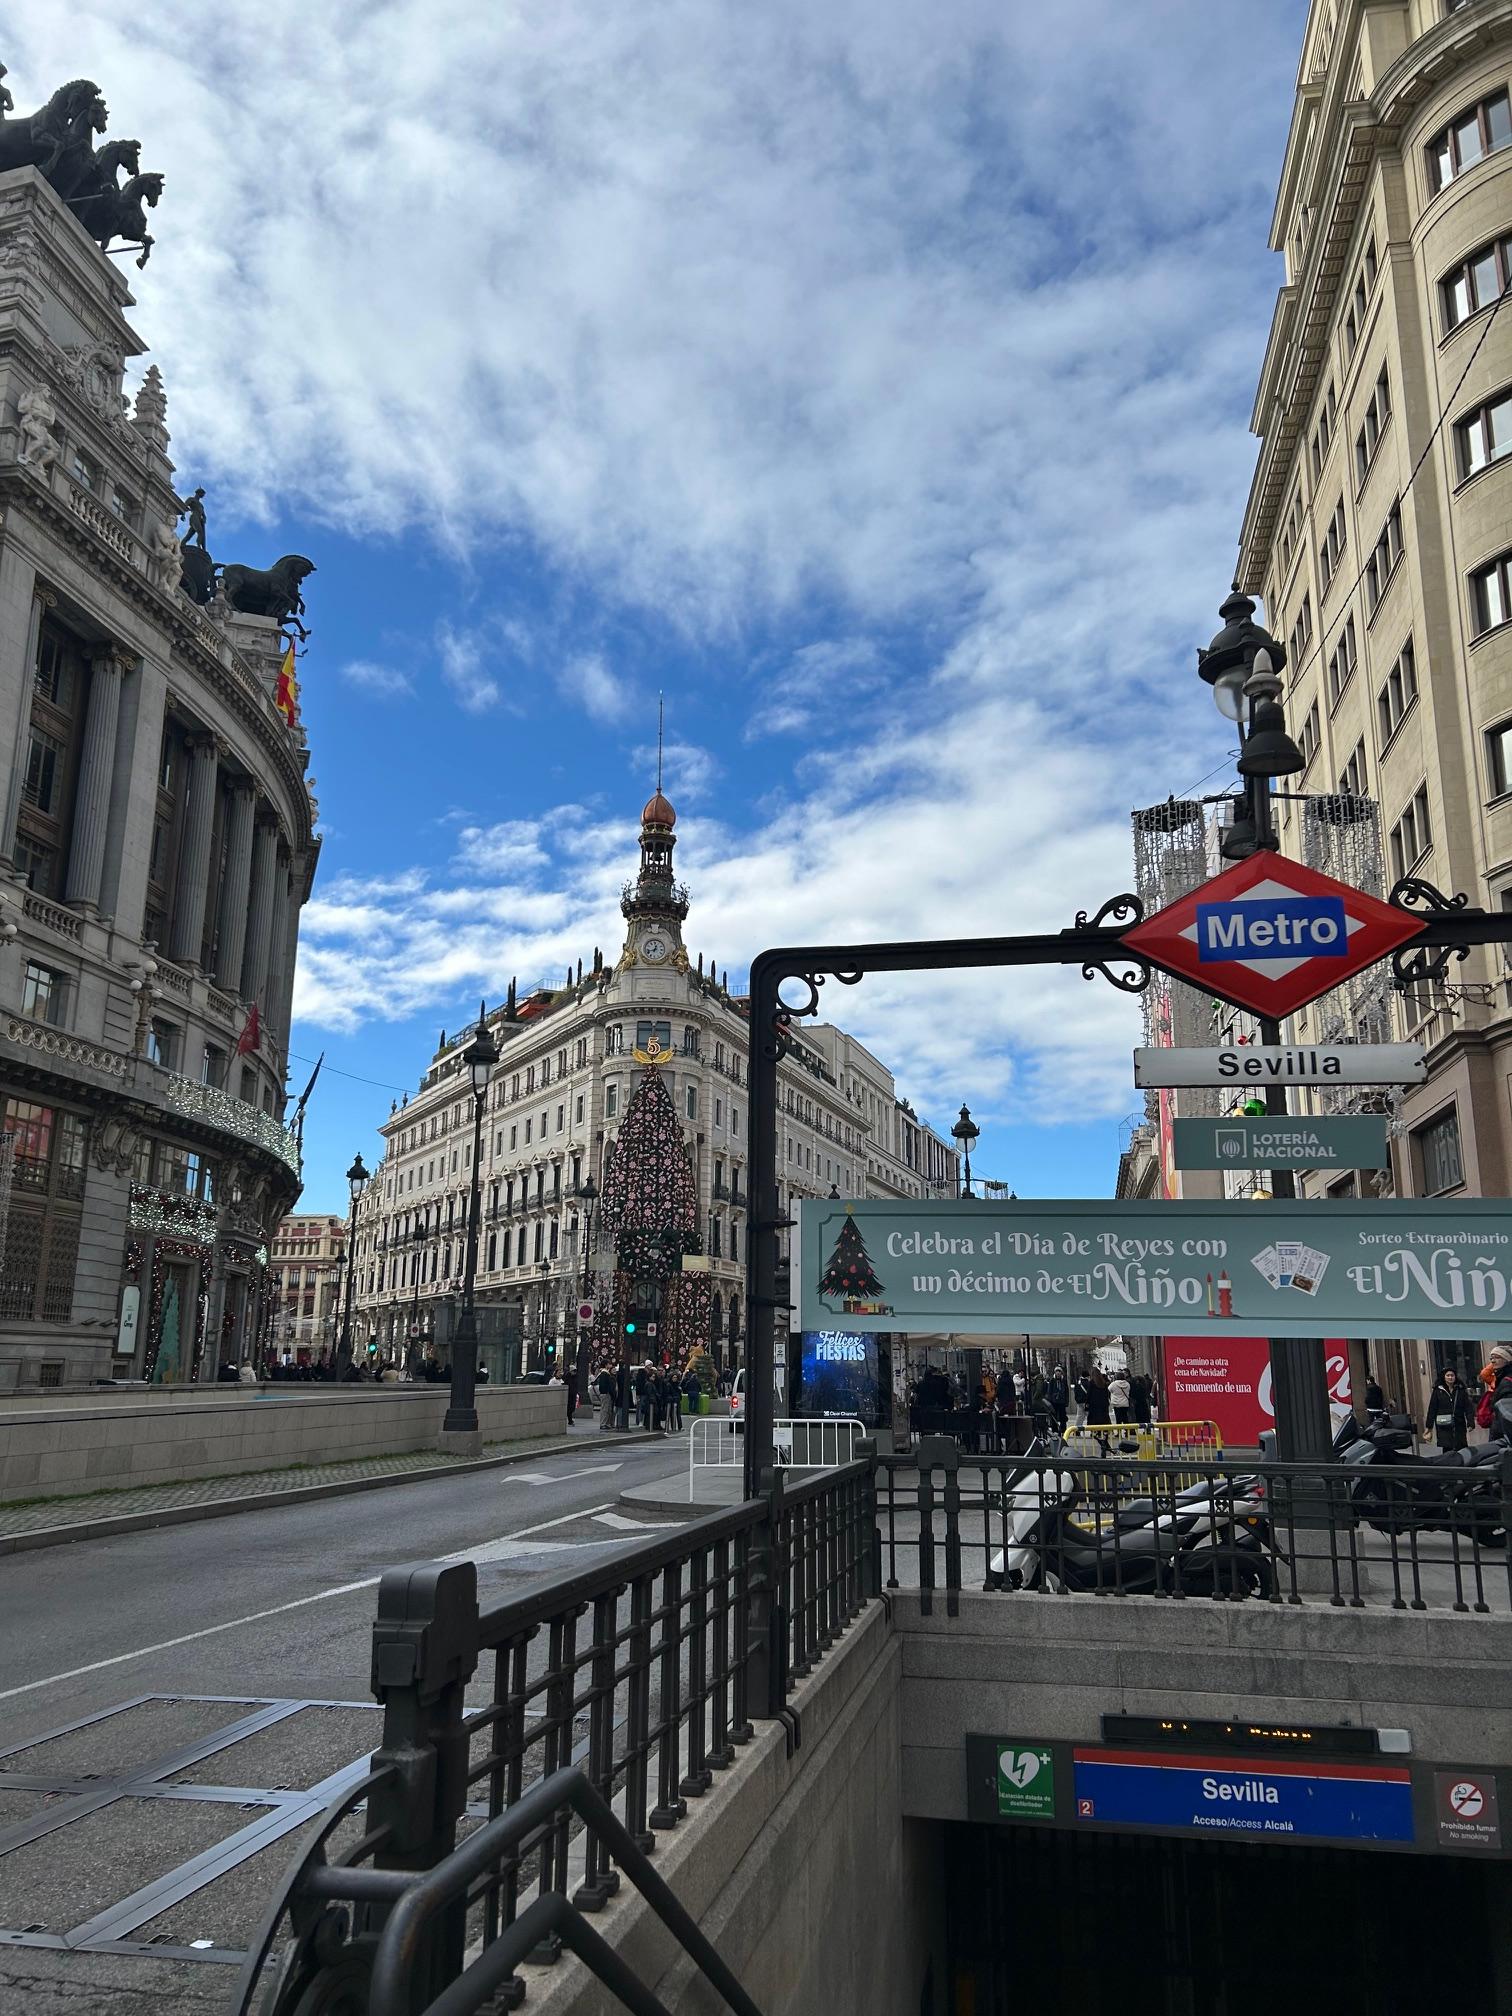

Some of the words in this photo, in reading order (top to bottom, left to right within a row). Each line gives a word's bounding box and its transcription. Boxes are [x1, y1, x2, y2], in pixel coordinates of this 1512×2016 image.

[1206, 912, 1339, 950] Metro
[647, 1036, 661, 1055] 5
[1217, 1051, 1342, 1078] Sevilla
[1252, 1130, 1319, 1146] LOTERÍA
[1252, 1144, 1338, 1159] NACIONAL
[887, 1231, 975, 1258] Celebra
[981, 1231, 1001, 1255] el
[1008, 1232, 1055, 1256] Día
[1062, 1232, 1091, 1256] de
[1097, 1232, 1174, 1261] Reyes
[1181, 1236, 1228, 1259] con
[1359, 1231, 1402, 1245] Sorteo
[1405, 1231, 1509, 1246] Extraordinario
[912, 1275, 942, 1295] un
[947, 1269, 1031, 1294] décimo
[1036, 1269, 1065, 1294] de
[1067, 1274, 1092, 1295] El
[1092, 1261, 1203, 1308] Niño
[1346, 1265, 1383, 1294] El
[1384, 1248, 1512, 1312] Niñ
[818, 1330, 864, 1346] Felices
[816, 1344, 866, 1361] FIESTAS
[1174, 1357, 1185, 1367] ¿De
[1186, 1357, 1209, 1366] camino
[1215, 1358, 1229, 1366] otra
[1190, 1368, 1198, 1376] de
[1199, 1368, 1227, 1377] Navidad?
[1175, 1382, 1185, 1392] Es
[1185, 1382, 1223, 1393] momento
[1225, 1382, 1235, 1393] de
[1235, 1384, 1251, 1393] una
[1202, 1778, 1279, 1804] Sevilla
[1082, 1801, 1091, 1814] 2
[1193, 1815, 1262, 1830] Acceso/Access
[1264, 1818, 1294, 1832] Alcalá
[1440, 1821, 1475, 1831] Prohibido
[1476, 1824, 1496, 1832] fumar
[1461, 1833, 1489, 1842] smoking
